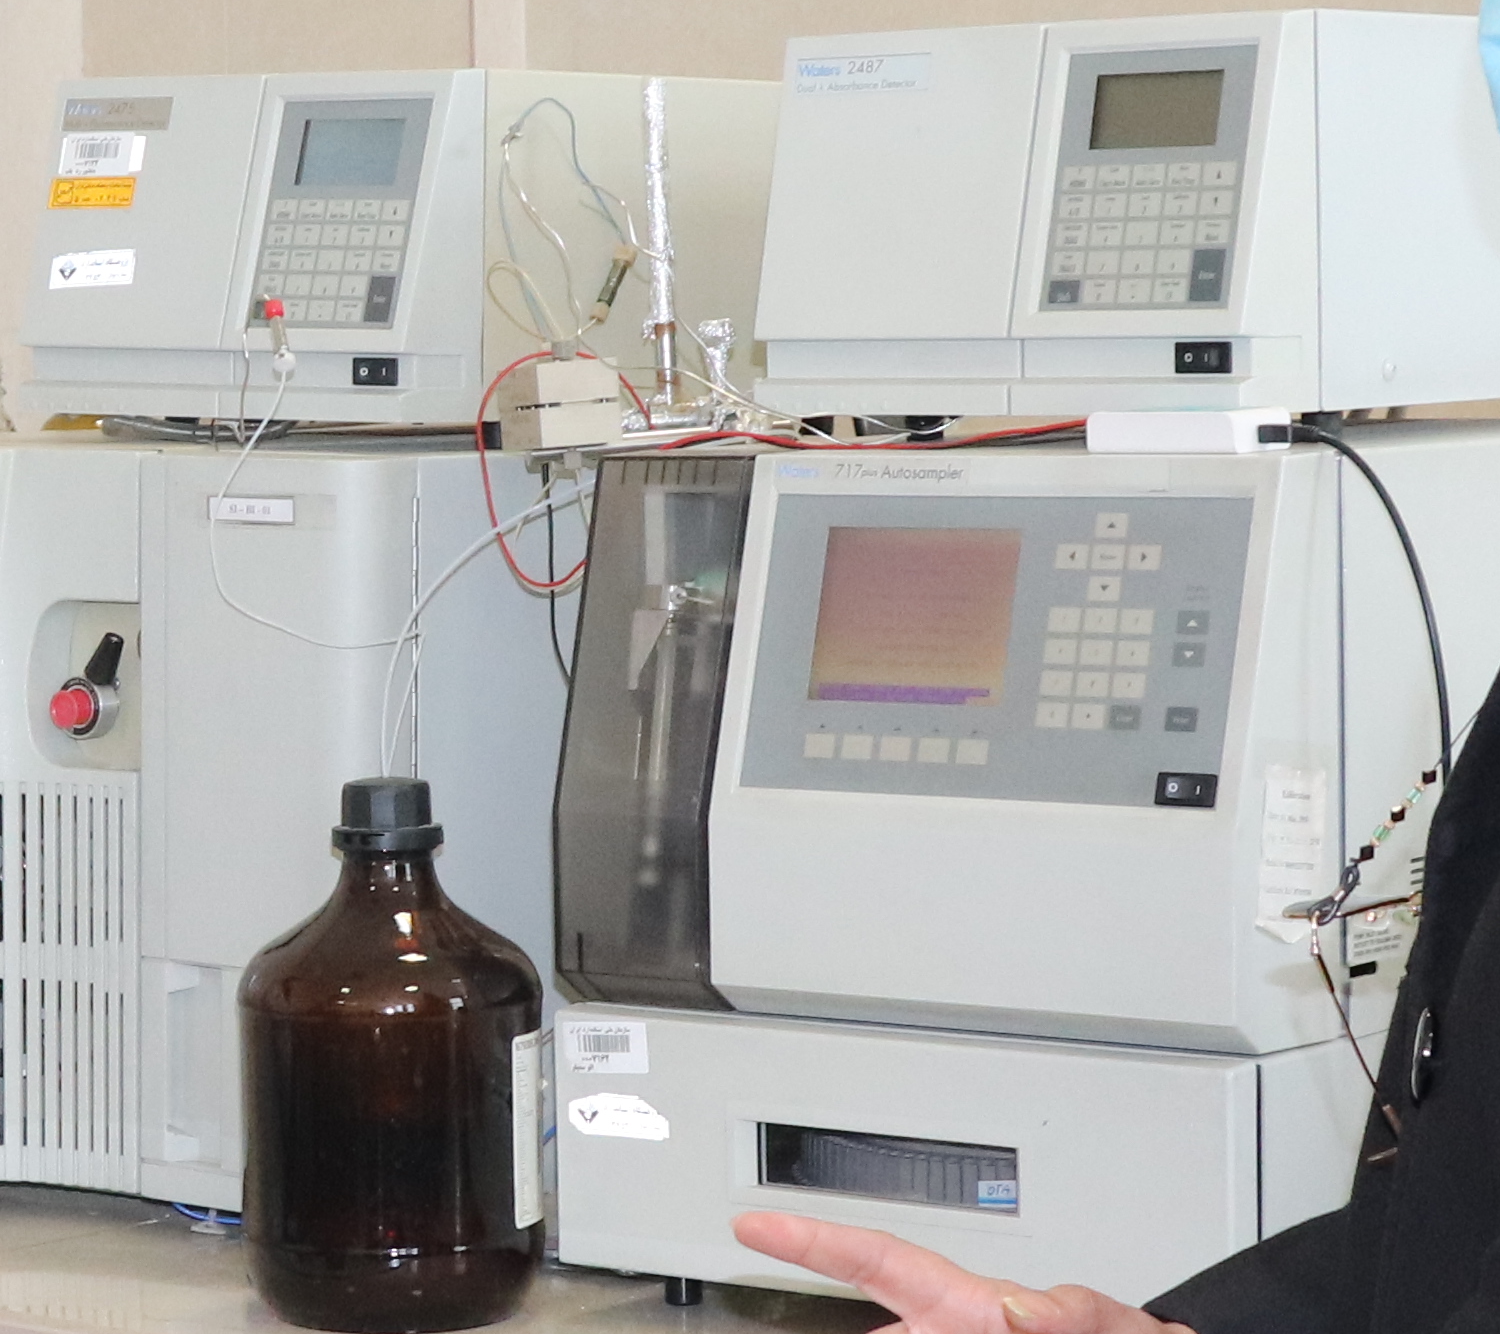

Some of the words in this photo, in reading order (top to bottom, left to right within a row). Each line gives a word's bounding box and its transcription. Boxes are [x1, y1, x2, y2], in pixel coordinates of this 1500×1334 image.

[799, 63, 841, 77] Waters
[848, 59, 884, 75] 2487
[827, 80, 879, 92] Absorbance
[882, 79, 917, 89] Detector
[108, 101, 135, 115] 2475
[881, 464, 964, 482] Autosampler
